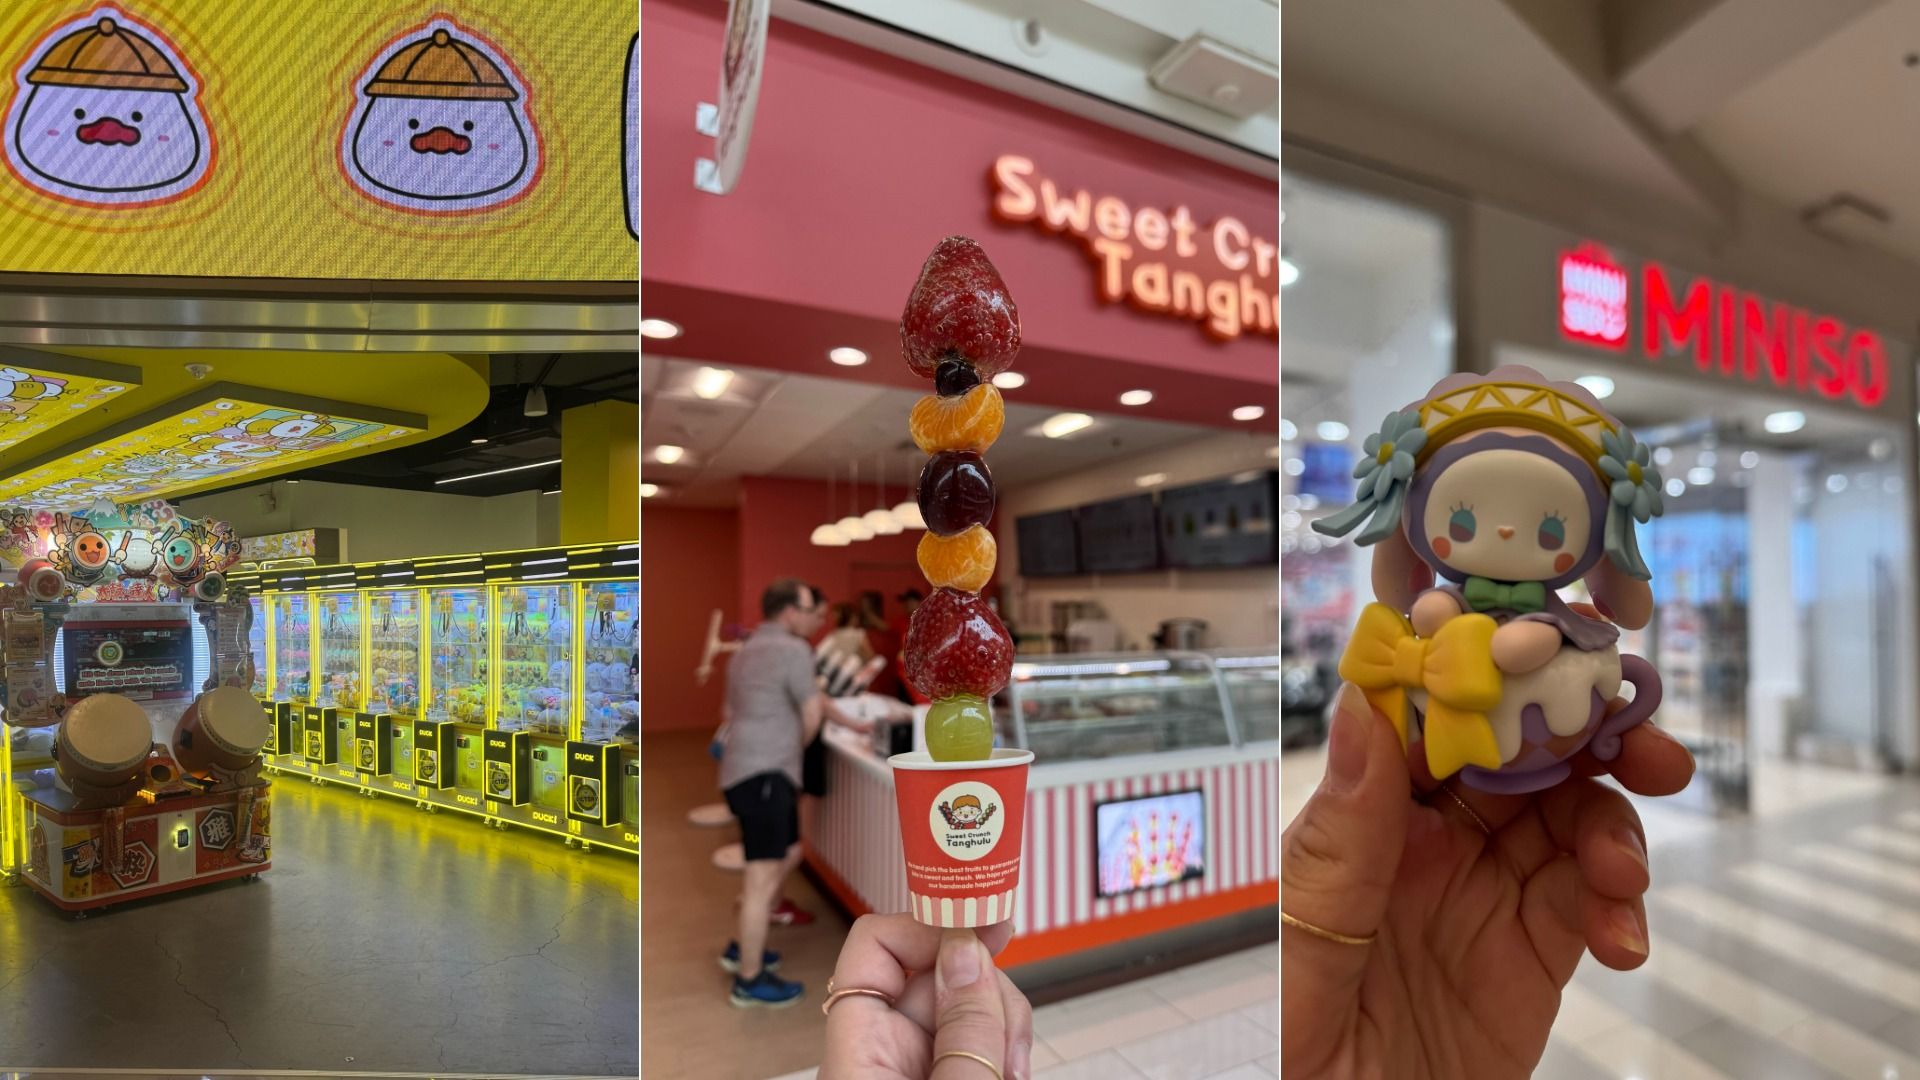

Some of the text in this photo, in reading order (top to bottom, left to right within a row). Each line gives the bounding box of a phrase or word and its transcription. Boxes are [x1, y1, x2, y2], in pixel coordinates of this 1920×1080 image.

[994, 153, 1279, 278] Sweet Cr
[1641, 259, 1888, 408] MINISO
[419, 729, 433, 737] DUCK
[489, 740, 506, 748] DUCK
[574, 752, 594, 762] DUCK
[457, 794, 478, 806] DUCK!
[532, 811, 557, 824] DUCK!
[624, 832, 639, 843] DU
[946, 837, 991, 849] Tanghulu
[986, 871, 1000, 879] hope
[938, 881, 974, 889] handmade
